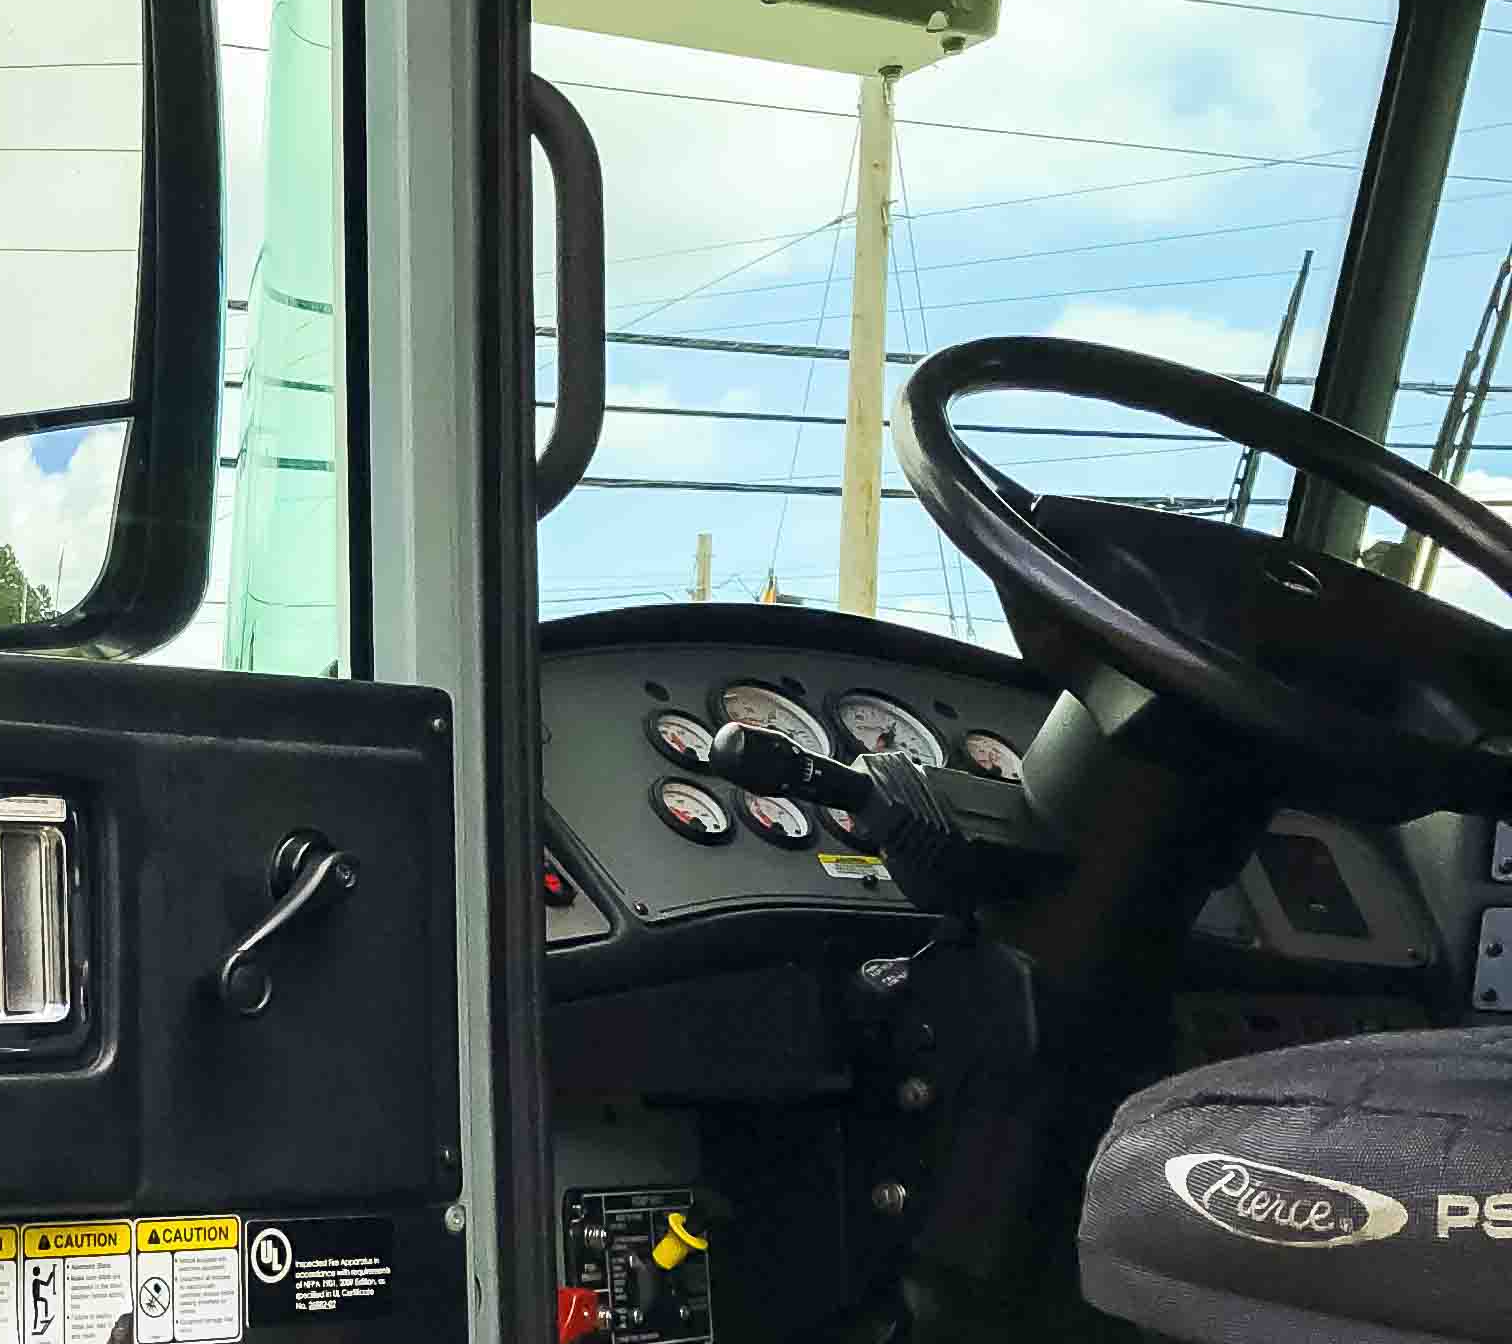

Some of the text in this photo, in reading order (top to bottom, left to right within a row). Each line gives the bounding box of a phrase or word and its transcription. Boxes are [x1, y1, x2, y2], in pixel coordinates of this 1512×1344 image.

[1202, 1164, 1334, 1231] Pierce
[54, 1232, 117, 1249] CAUTION
[162, 1226, 229, 1244] CAUTION
[260, 1239, 283, 1271] UL
